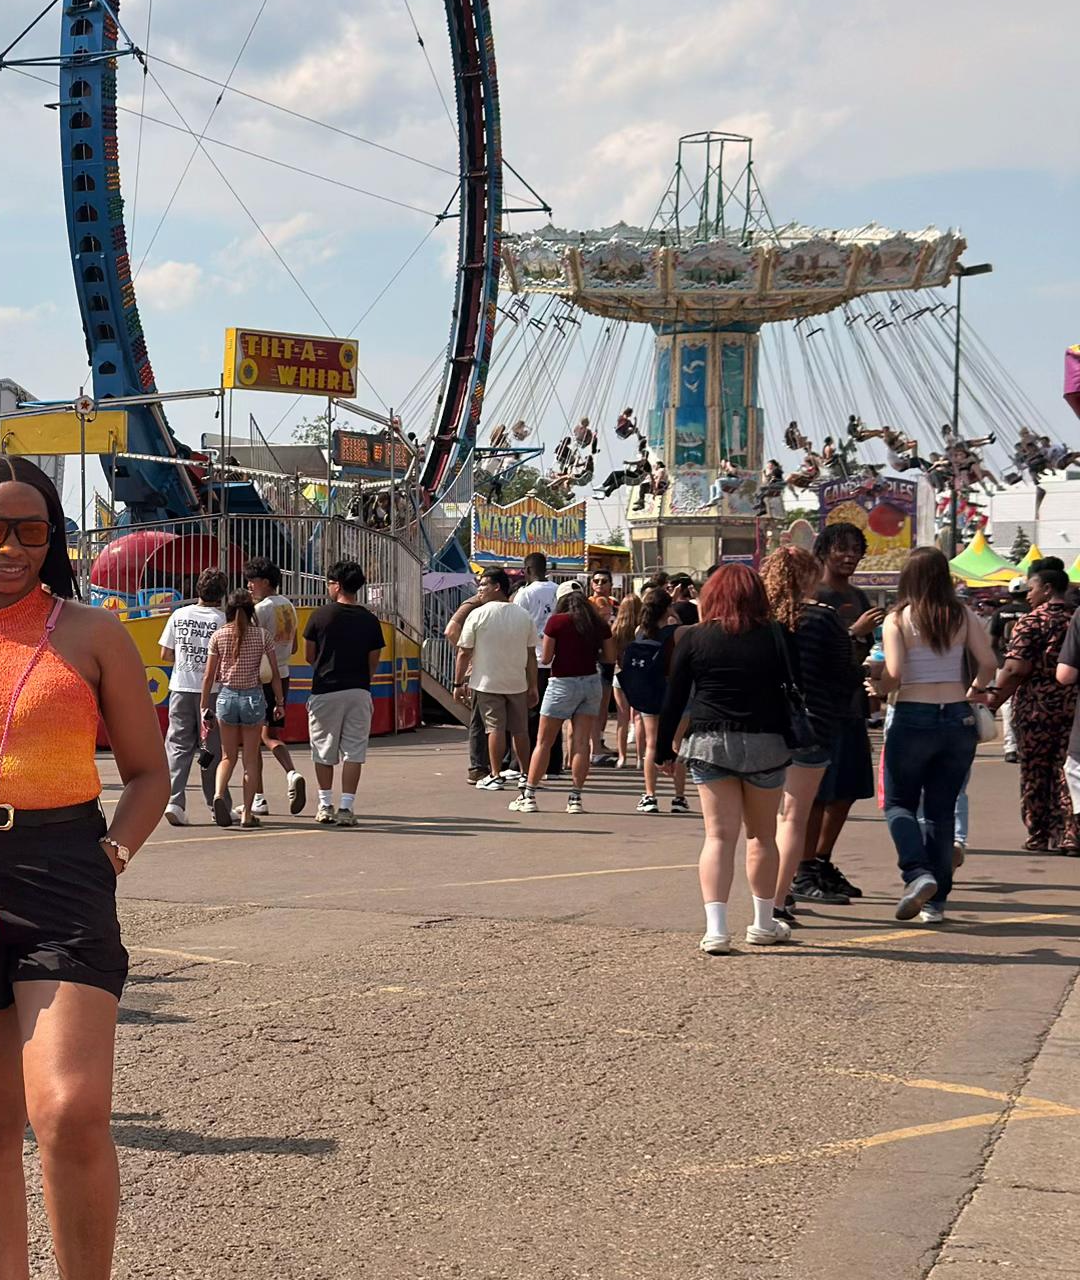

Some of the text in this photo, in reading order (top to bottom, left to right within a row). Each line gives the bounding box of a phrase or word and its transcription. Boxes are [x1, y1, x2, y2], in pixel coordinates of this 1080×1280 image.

[277, 365, 353, 391] WHIRL
[479, 514, 521, 540] WATER
[526, 513, 553, 544] GUN
[174, 620, 217, 631] LEARNING
[178, 628, 214, 639] TO PAUS
[194, 655, 207, 664] OU
